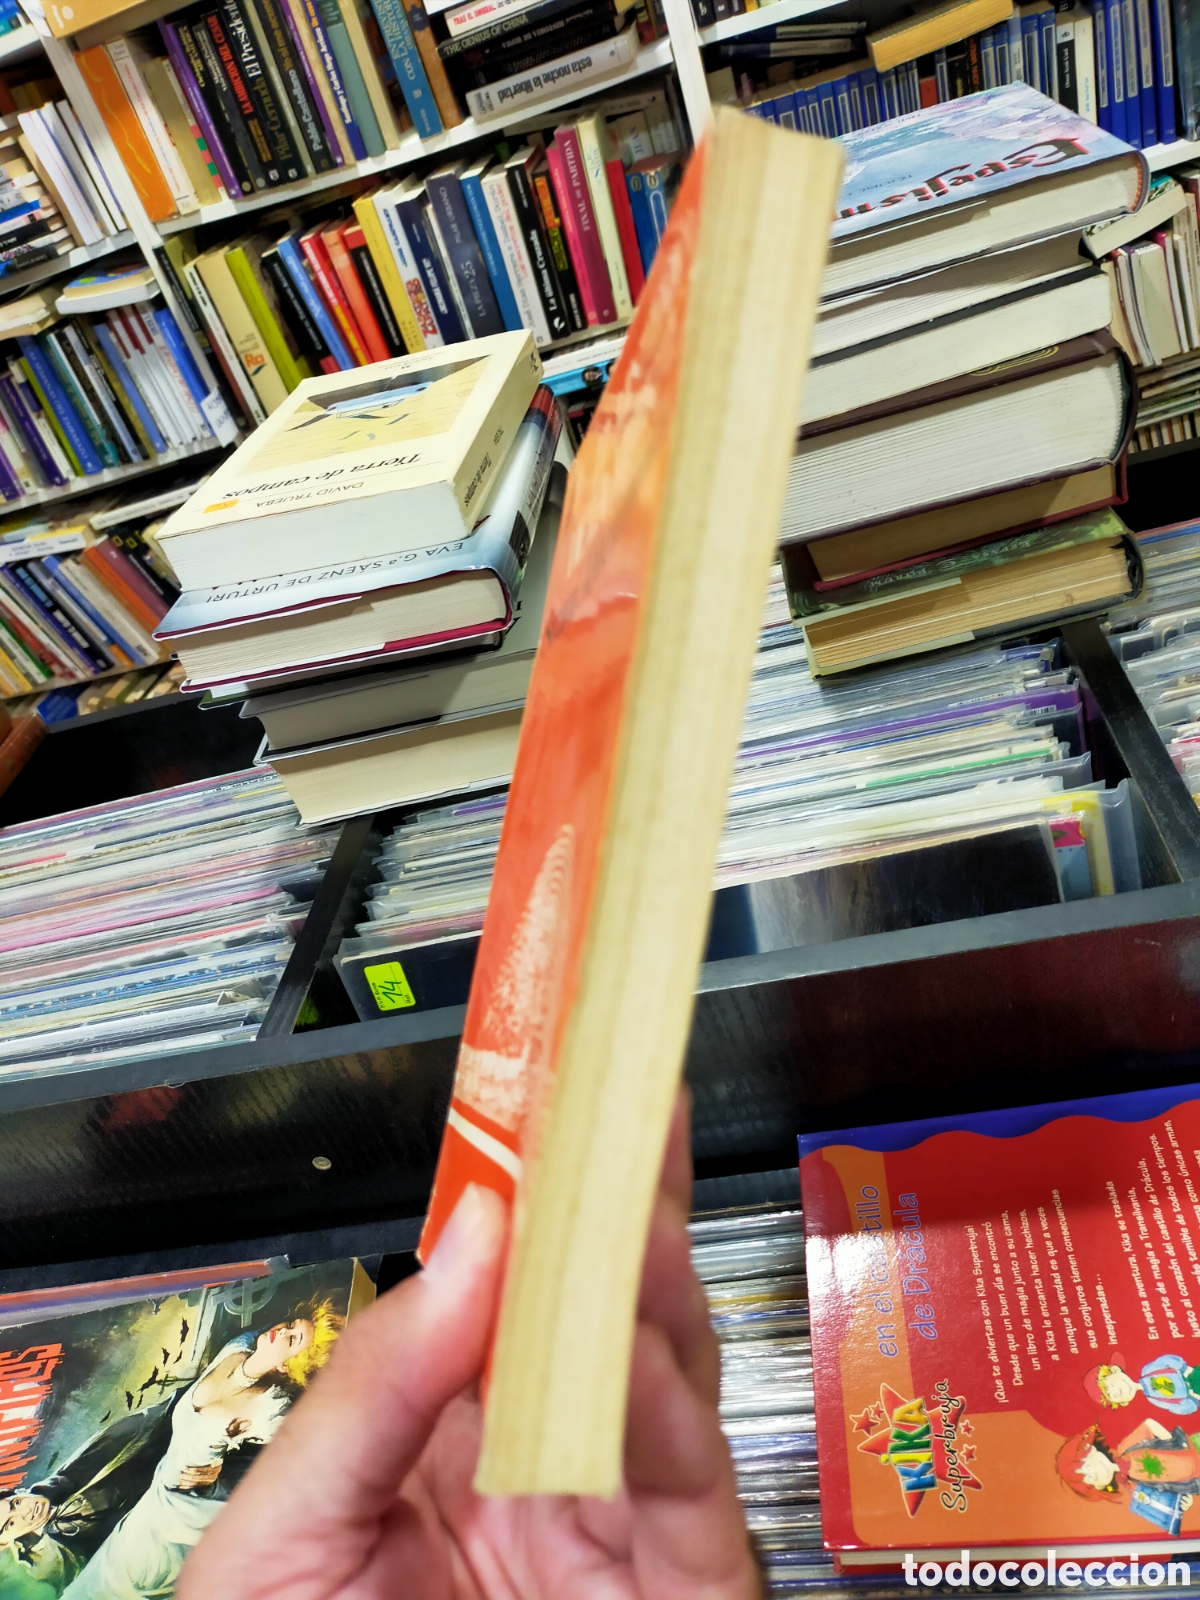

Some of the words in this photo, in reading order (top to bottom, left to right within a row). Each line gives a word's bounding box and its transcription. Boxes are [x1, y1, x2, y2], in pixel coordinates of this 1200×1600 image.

[206, 14, 226, 44] CESAR
[372, 0, 401, 60] ENTREVIST
[443, 43, 462, 55] THE
[460, 29, 492, 49] GENIUS
[491, 25, 503, 37] OF
[501, 14, 530, 33] CHINA
[217, 43, 233, 61] DEL
[398, 43, 409, 57] LA
[245, 61, 262, 78] El
[403, 57, 416, 81] CON
[541, 64, 572, 85] noche
[571, 57, 593, 74] esta
[224, 59, 249, 103] AMBICION
[496, 79, 534, 103] libertad
[532, 75, 543, 90] la
[240, 101, 254, 114] LA
[285, 69, 314, 123] Castellano
[304, 121, 324, 151] Pablo
[560, 139, 584, 187] PARTIDA
[833, 138, 1089, 221] Espejism
[438, 185, 456, 222] URBANO
[575, 199, 593, 231] FINAL
[450, 222, 463, 243] PILAR
[527, 229, 547, 268] Cruzada
[460, 260, 476, 279] 25
[507, 252, 524, 288] Herrera
[476, 303, 486, 317] LA
[547, 297, 558, 311] La
[316, 469, 344, 481] de
[351, 453, 423, 473] Tierra
[223, 476, 310, 500] campos
[256, 491, 312, 508] TRUEBA
[317, 482, 364, 495] DAVID
[426, 542, 463, 556] EVA
[287, 574, 312, 587] DE
[318, 560, 382, 582] SÁENZ
[206, 582, 279, 603] URTURI
[378, 980, 403, 1004] 14
[1161, 1118, 1180, 1149] armas,
[1147, 1132, 1168, 1170] tiempos.
[1171, 1148, 1190, 1178] únicas
[1135, 1157, 1156, 1194] Drácula,
[1158, 1170, 1172, 1185] los
[1104, 1180, 1124, 1219] traslada
[1147, 1193, 1159, 1206] de
[1164, 1184, 1181, 1213] todos
[1183, 1177, 1199, 1204] como
[1000, 1209, 1014, 1237] cama,
[1036, 1206, 1049, 1231] veces
[1050, 1188, 1074, 1253] consecuencias
[1117, 1219, 1127, 1231] se
[1126, 1186, 1150, 1241] Transilvania,
[1151, 1206, 1170, 1242] castillo
[1174, 1213, 1187, 1227] de
[1017, 1208, 1035, 1249] hechizos,
[890, 1191, 931, 1296] Drácula
[964, 1224, 986, 1276] Superbruja!
[981, 1220, 999, 1262] encontró
[1006, 1238, 1015, 1250] su
[1045, 1239, 1058, 1257] que
[1119, 1232, 1134, 1253] Kika
[1144, 1241, 1153, 1249] a
[1162, 1241, 1175, 1258] del
[1179, 1227, 1198, 1263] temible
[992, 1263, 1001, 1274] se
[1010, 1259, 1026, 1286] junto
[1026, 1249, 1040, 1276] hacer
[1049, 1259, 1059, 1271] es
[1067, 1253, 1082, 1283] tienen
[1145, 1249, 1164, 1281] magia
[973, 1277, 987, 1297] Kika
[992, 1276, 1005, 1292] día
[1126, 1253, 1148, 1299] aventura,
[1154, 1281, 1167, 1295] de
[1167, 1257, 1189, 1298] corazón
[1033, 1277, 1050, 1318] encanta
[1050, 1272, 1067, 1305] verdad
[865, 1291, 893, 1316] el
[979, 1299, 991, 1317] con
[996, 1293, 1010, 1317] buen
[1015, 1286, 1032, 1316] magia
[1058, 1305, 1069, 1316] la
[1074, 1284, 1095, 1328] conjuros
[1140, 1299, 1155, 1325] esta
[1159, 1296, 1175, 1320] arte
[1180, 1297, 1192, 1309] al
[906, 1303, 939, 1342] de
[1004, 1318, 1013, 1331] un
[1021, 1317, 1032, 1331] de
[1042, 1318, 1052, 1328] le
[1146, 1326, 1160, 1341] En
[1167, 1318, 1185, 1340] por
[875, 1322, 899, 1358] en
[981, 1318, 1000, 1364] diviertas
[1006, 1332, 1020, 1351] que
[1024, 1332, 1038, 1355] libro
[1044, 1330, 1058, 1352] Kika
[1062, 1316, 1081, 1355] aunque
[1086, 1329, 1098, 1349] sus
[990, 1364, 1002, 1377] te
[1008, 1353, 1024, 1387] Desde
[1031, 1357, 1041, 1371] un
[992, 1378, 1009, 1404] ¡Que
[936, 1379, 968, 1513] Superbruja
